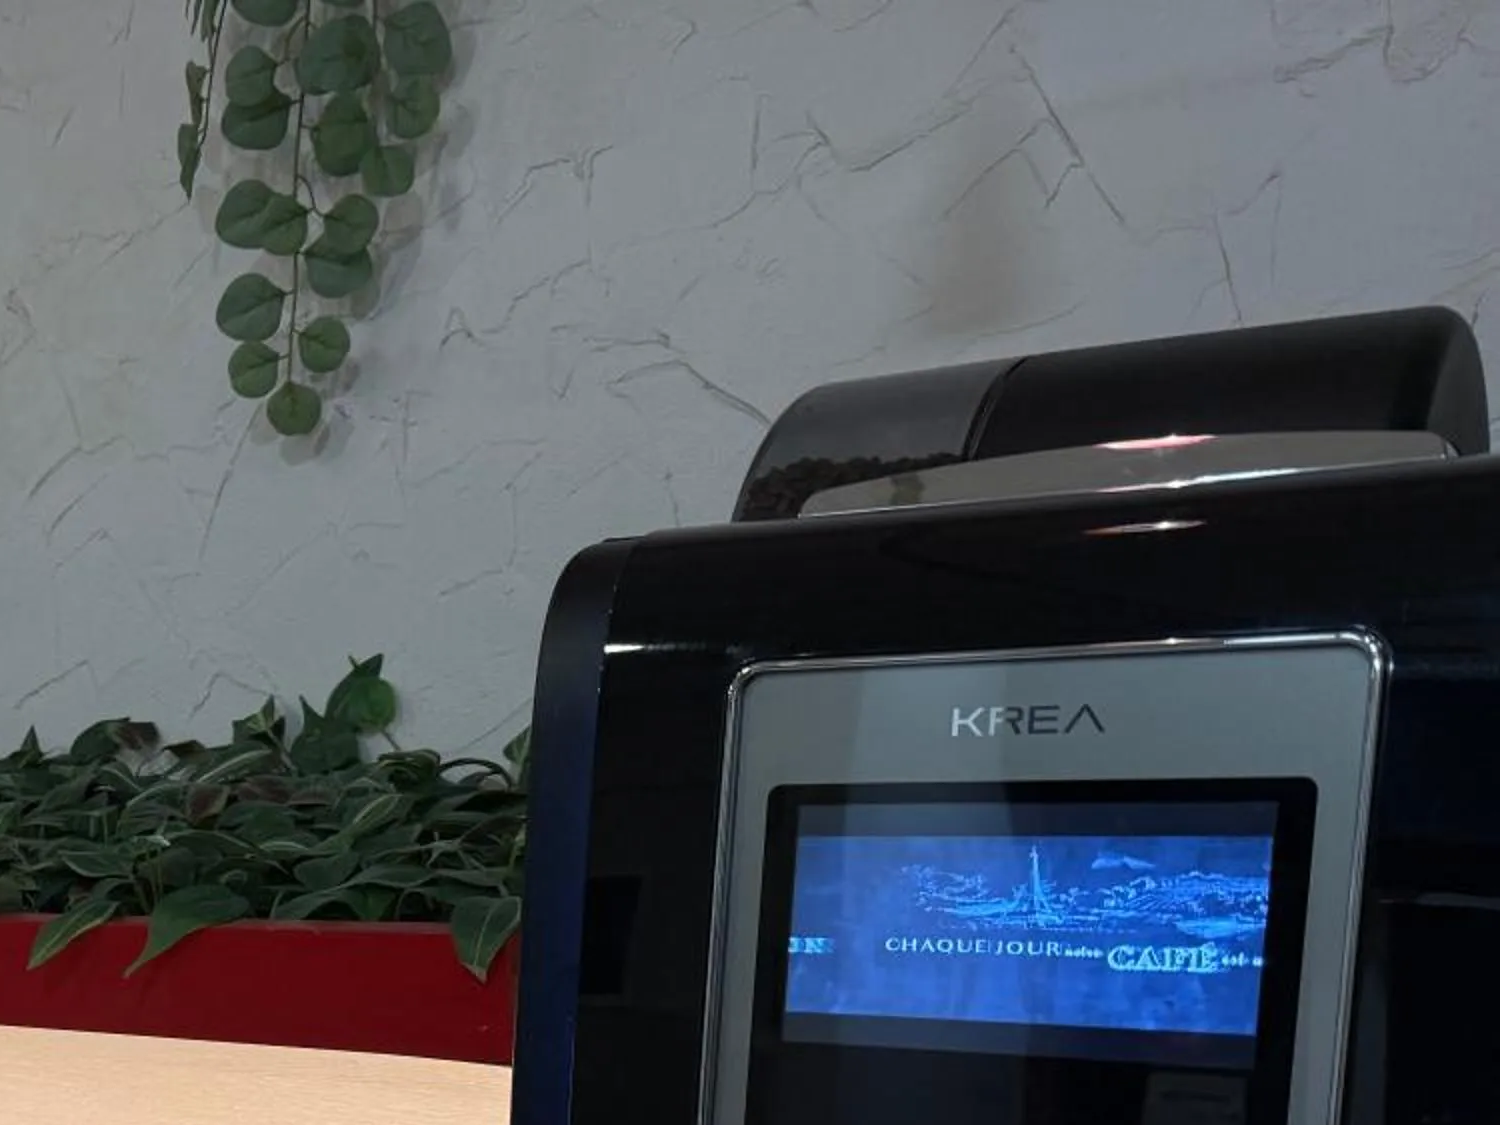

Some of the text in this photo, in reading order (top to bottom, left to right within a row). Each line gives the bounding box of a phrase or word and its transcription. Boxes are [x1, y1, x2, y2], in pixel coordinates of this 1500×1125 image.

[950, 703, 1106, 737] KREA
[884, 937, 988, 956] CHAQUE
[994, 939, 1062, 957] JOUR
[1107, 941, 1219, 974] CAFÉ
